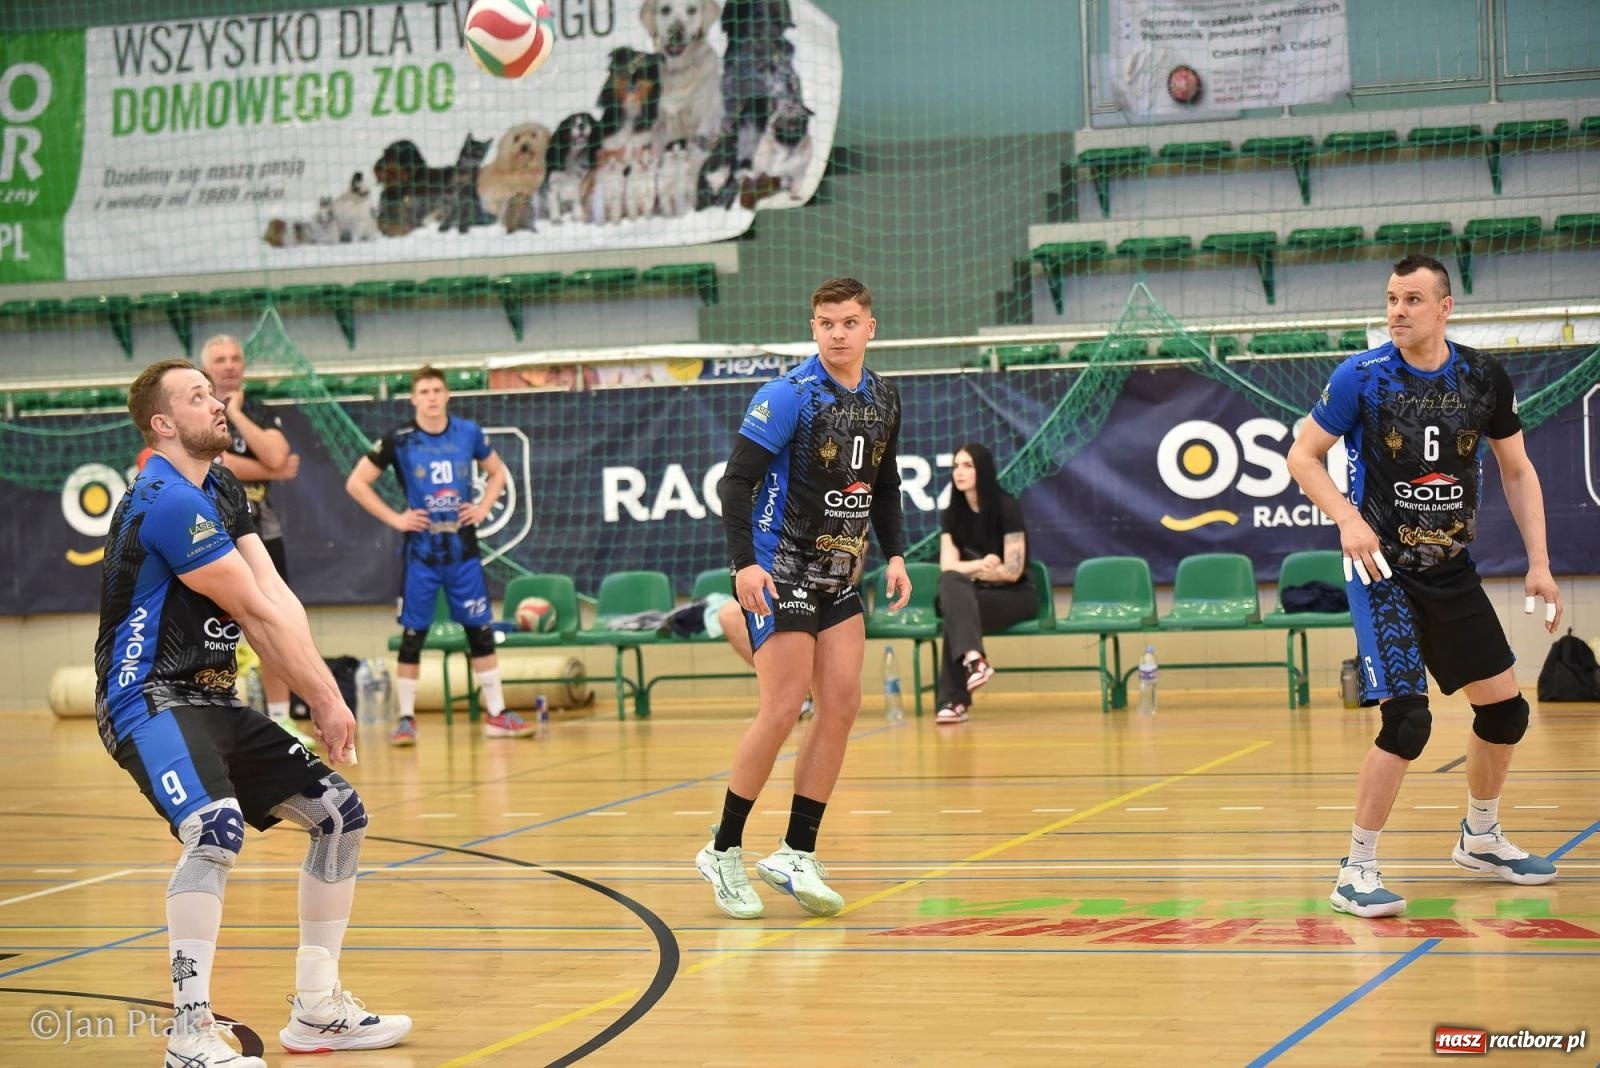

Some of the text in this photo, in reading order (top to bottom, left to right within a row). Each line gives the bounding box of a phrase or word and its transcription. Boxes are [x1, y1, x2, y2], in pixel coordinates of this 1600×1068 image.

[113, 13, 320, 77] WSZYSTKO
[339, 7, 412, 59] DLA
[112, 61, 455, 137] DOMOWEGO ZOO
[852, 436, 865, 470] 0
[1424, 426, 1440, 461] 6
[430, 460, 453, 484] 20
[824, 490, 873, 509] GOLD
[1394, 481, 1463, 500] GOLD
[824, 509, 855, 518] POKRYCIA
[1394, 499, 1463, 512] POKRYCIA DACHOWE
[161, 770, 188, 806] 9
